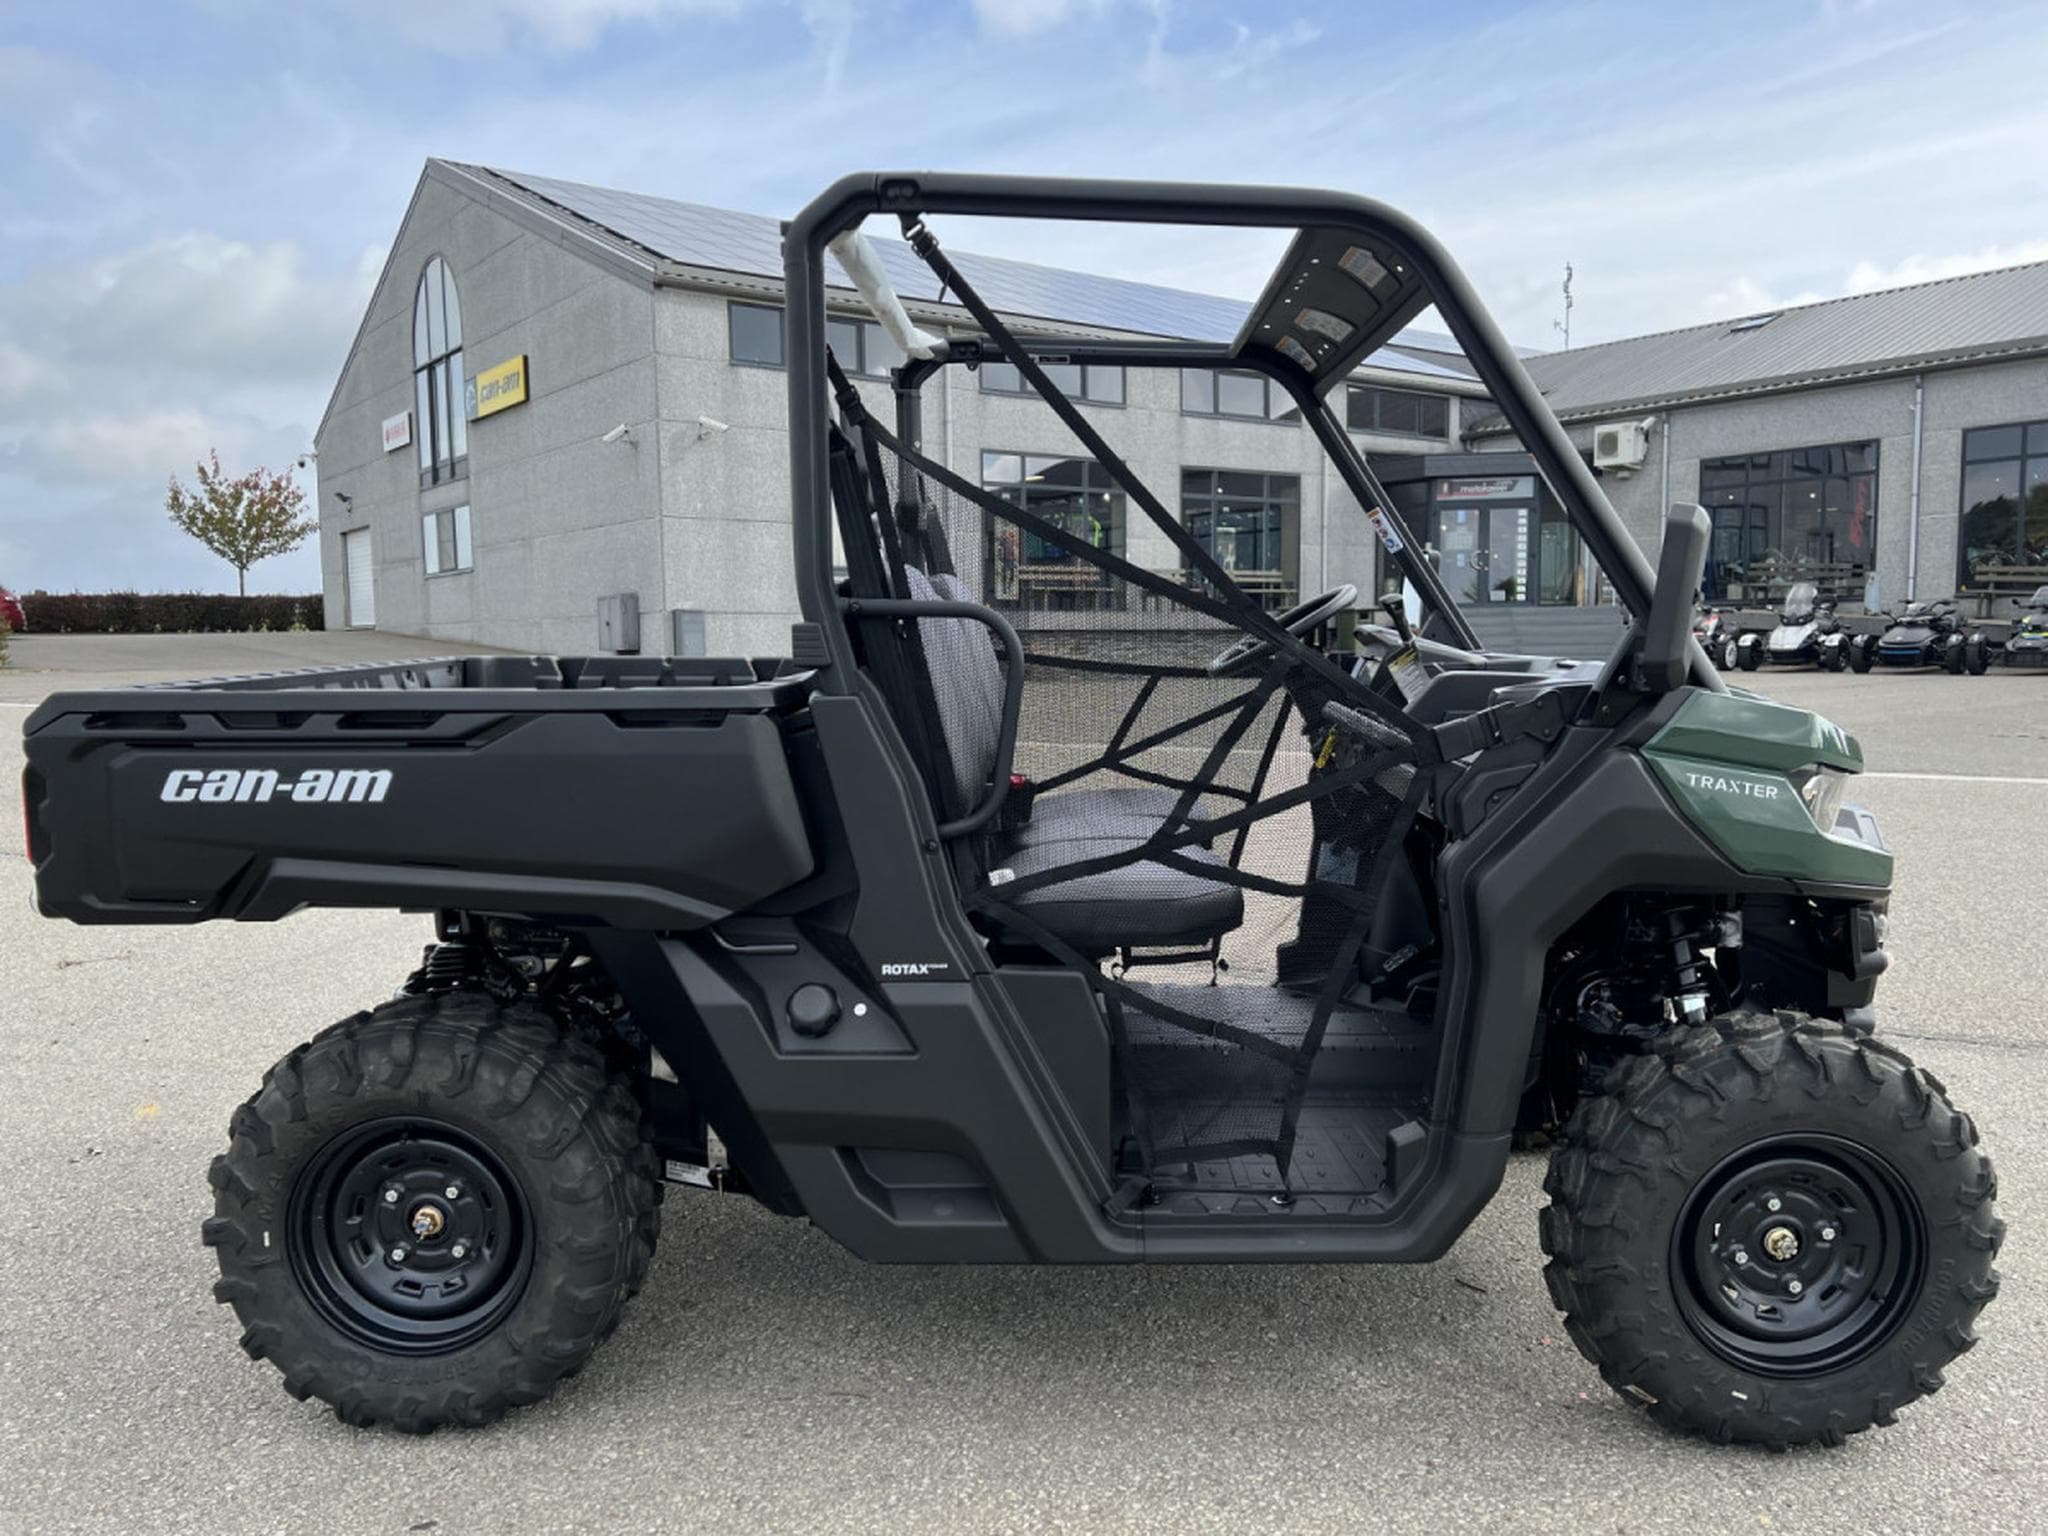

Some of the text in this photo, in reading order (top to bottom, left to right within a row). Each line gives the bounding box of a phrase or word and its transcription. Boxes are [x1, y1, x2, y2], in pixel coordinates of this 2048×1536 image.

[480, 371, 521, 404] can-am
[160, 769, 393, 802] can-am
[1686, 772, 1779, 799] TRAXTER
[881, 963, 929, 975] ROTAX
